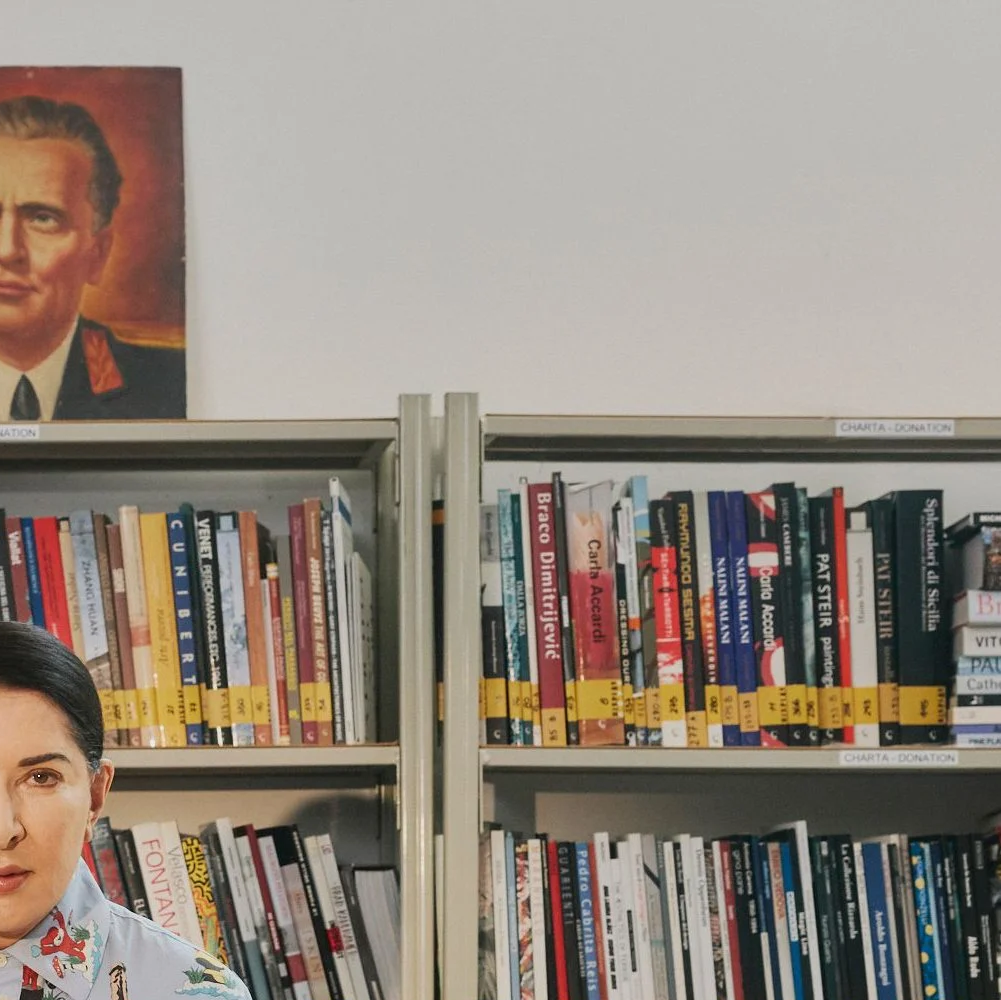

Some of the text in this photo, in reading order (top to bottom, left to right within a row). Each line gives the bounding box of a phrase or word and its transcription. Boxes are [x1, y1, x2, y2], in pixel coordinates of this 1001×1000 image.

[840, 423, 951, 432] CHARTA DONATION
[197, 518, 213, 560] VENET
[310, 557, 323, 593] JOSEPH
[536, 492, 560, 661] Braco Dimitrijević
[677, 503, 695, 641] RAYMUNDO SESMA
[816, 553, 831, 582] PAT
[922, 497, 940, 632] Splendori di Sicilia
[81, 560, 99, 636] ZHANG HUAN
[170, 519, 197, 686] CUNIBERT
[588, 539, 606, 644] Carla Accardi
[619, 599, 631, 656] DRESSING
[715, 557, 731, 644] NALINI MALANI
[735, 556, 750, 644] NALINI MALANI
[758, 568, 776, 651] Carla Accardi
[819, 585, 833, 628] STEIR
[876, 552, 893, 639] PAT STEIR
[314, 626, 325, 640] THE
[315, 643, 326, 657] ART
[316, 659, 327, 670] OF
[844, 753, 955, 762] CHARTA DONATION
[166, 846, 188, 904] Velasco
[558, 846, 573, 925] GUARIENTI
[840, 844, 850, 855] La
[142, 839, 181, 938] FONTAN
[577, 850, 598, 992] Pedro Cabrita Reis
